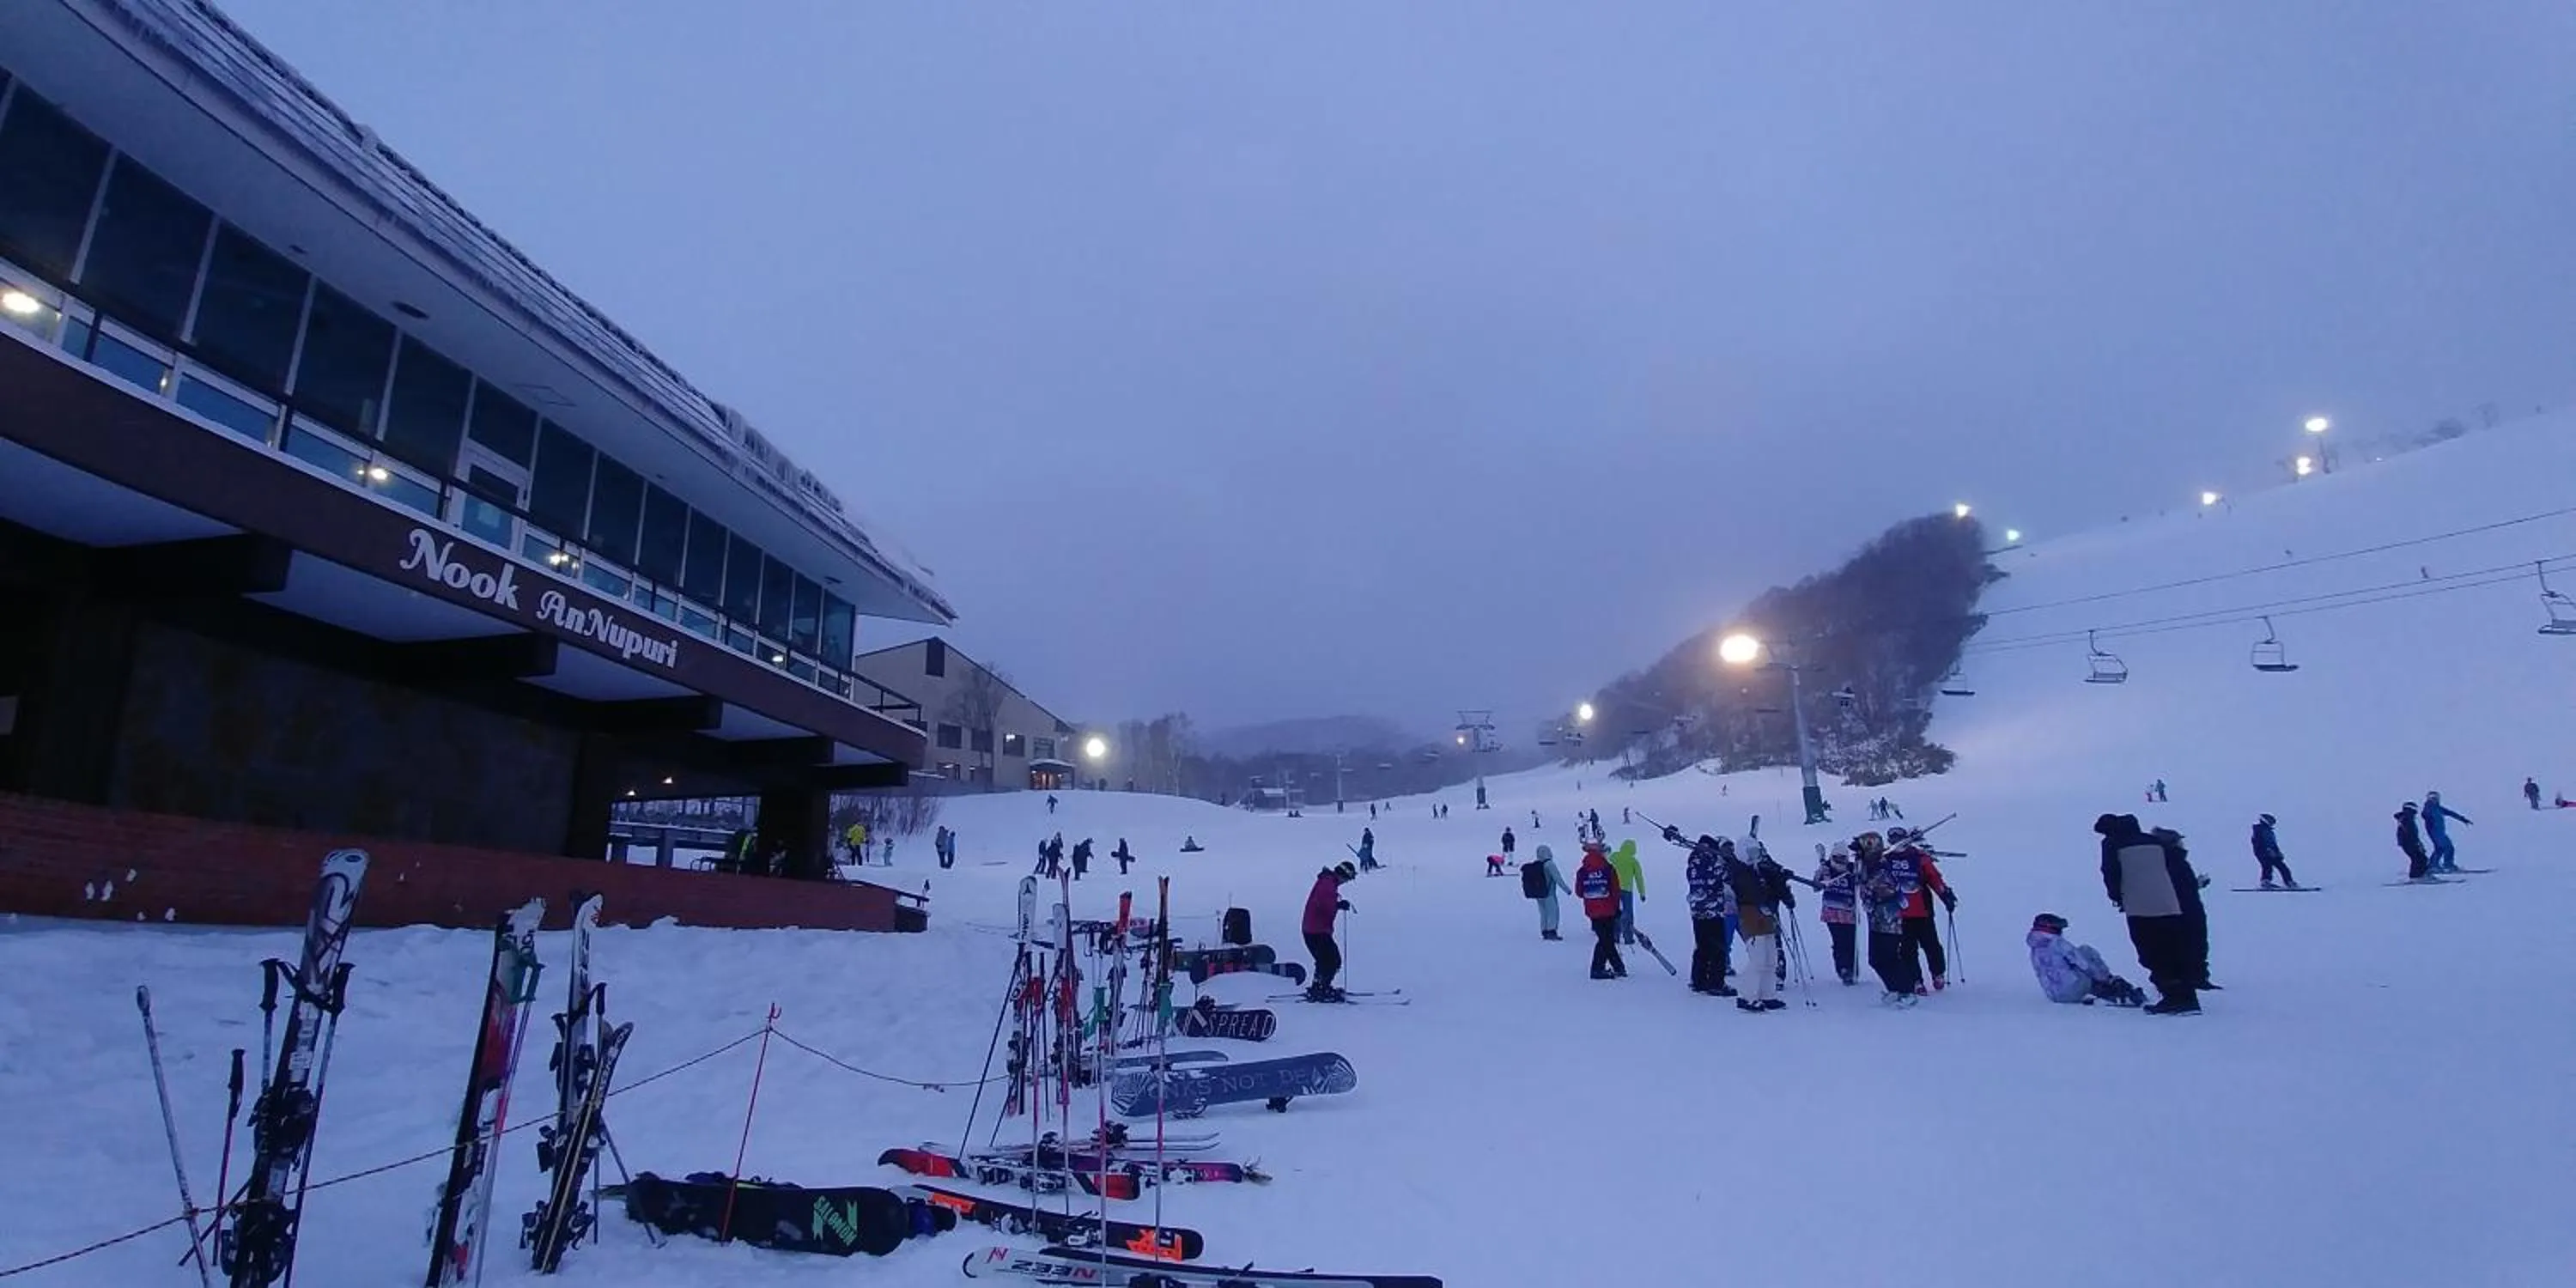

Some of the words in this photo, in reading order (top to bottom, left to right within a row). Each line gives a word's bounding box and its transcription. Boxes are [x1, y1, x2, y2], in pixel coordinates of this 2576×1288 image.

[399, 528, 519, 611] Nook
[536, 590, 679, 669] AnNupuri
[1220, 1072, 1267, 1093] NOT
[813, 1194, 858, 1247] SALOMON
